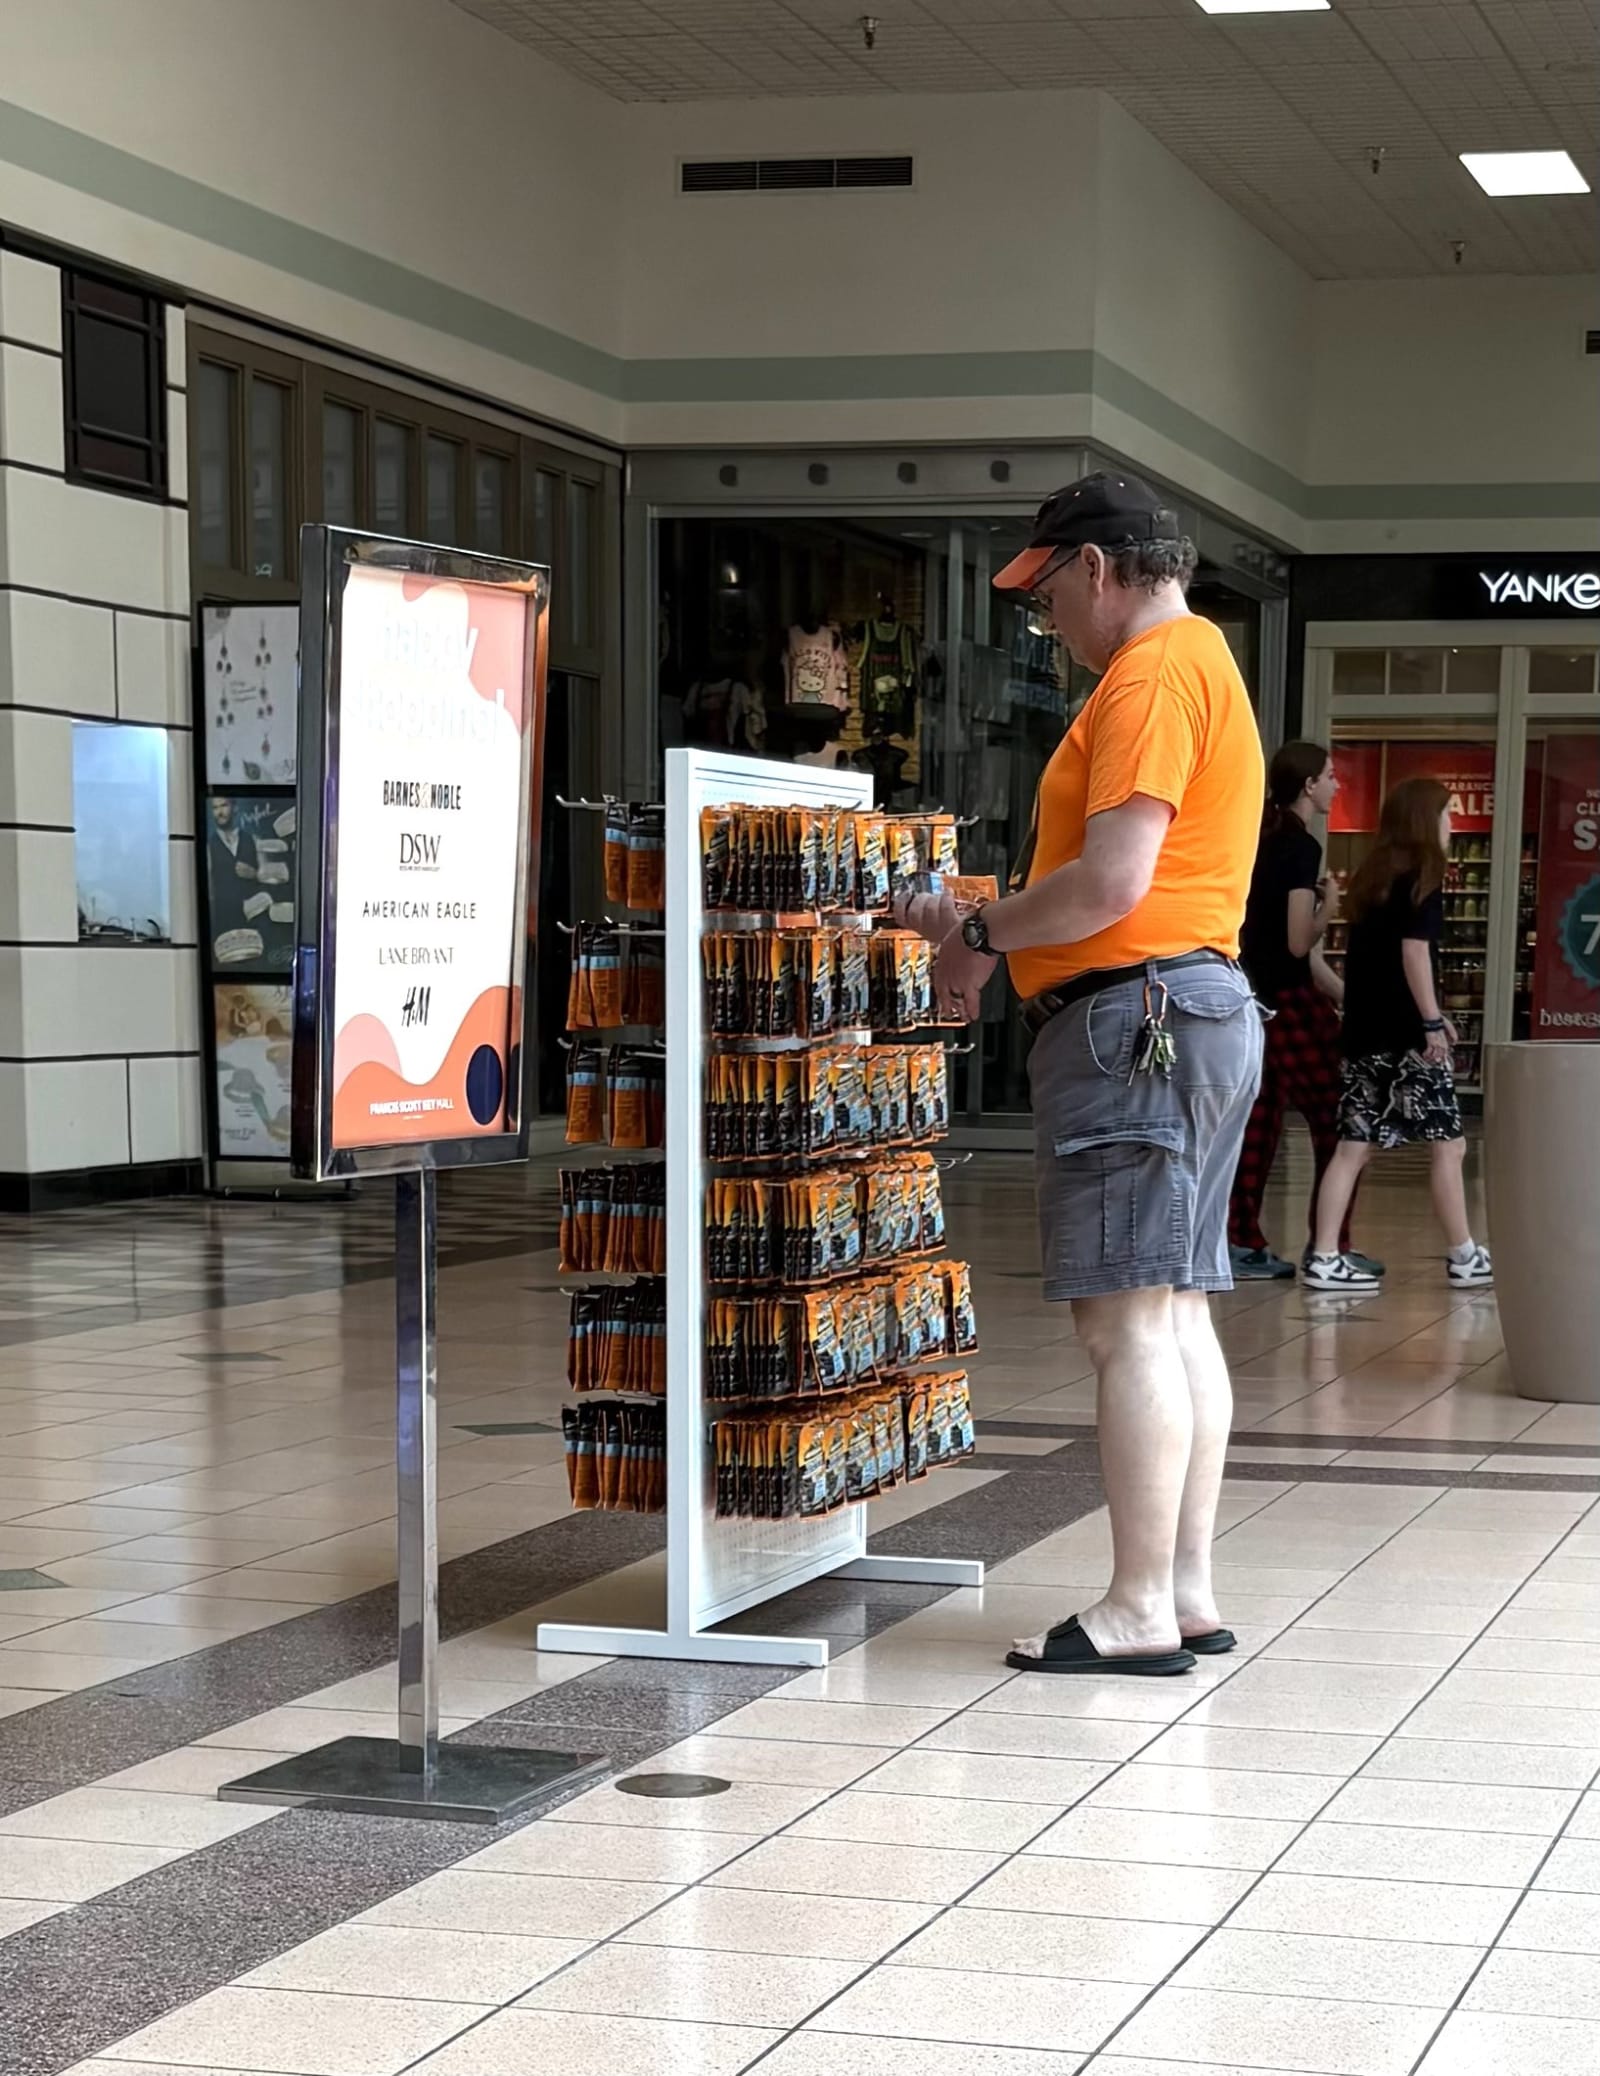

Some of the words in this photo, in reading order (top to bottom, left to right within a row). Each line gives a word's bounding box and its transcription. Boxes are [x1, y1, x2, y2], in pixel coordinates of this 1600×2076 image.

[1448, 794, 1495, 817] ALE
[1573, 819, 1600, 850] S
[400, 833, 442, 864] DSW
[362, 900, 430, 919] AMERICAN
[437, 901, 477, 919] EAGLE
